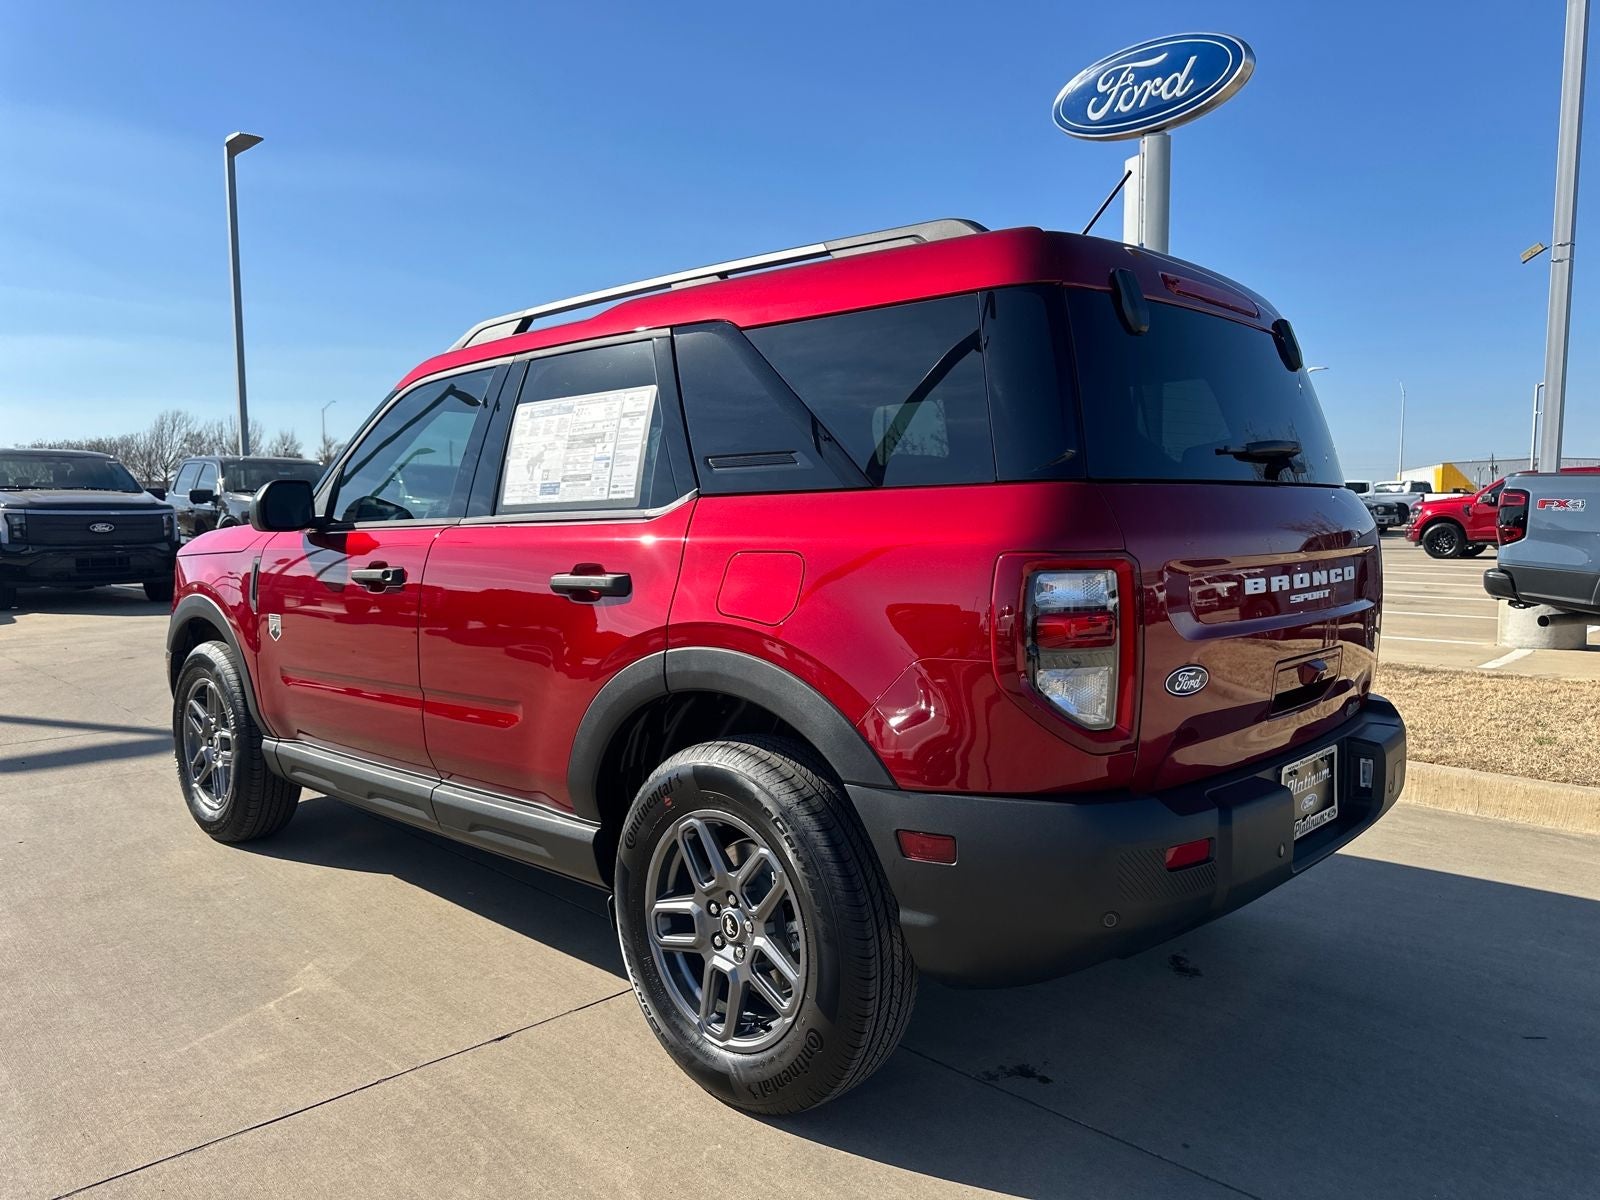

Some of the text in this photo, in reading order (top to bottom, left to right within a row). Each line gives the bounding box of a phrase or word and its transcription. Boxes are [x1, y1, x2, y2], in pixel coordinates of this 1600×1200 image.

[1087, 52, 1198, 121] Ford
[1537, 498, 1586, 509] FX4
[1244, 565, 1355, 596] BRONCO
[1289, 588, 1331, 604] SPORT
[1174, 670, 1202, 691] Ford
[1287, 767, 1332, 796] Platinum
[624, 776, 675, 850] Continental
[1294, 813, 1326, 837] Platinum
[757, 1028, 824, 1098] Continental
